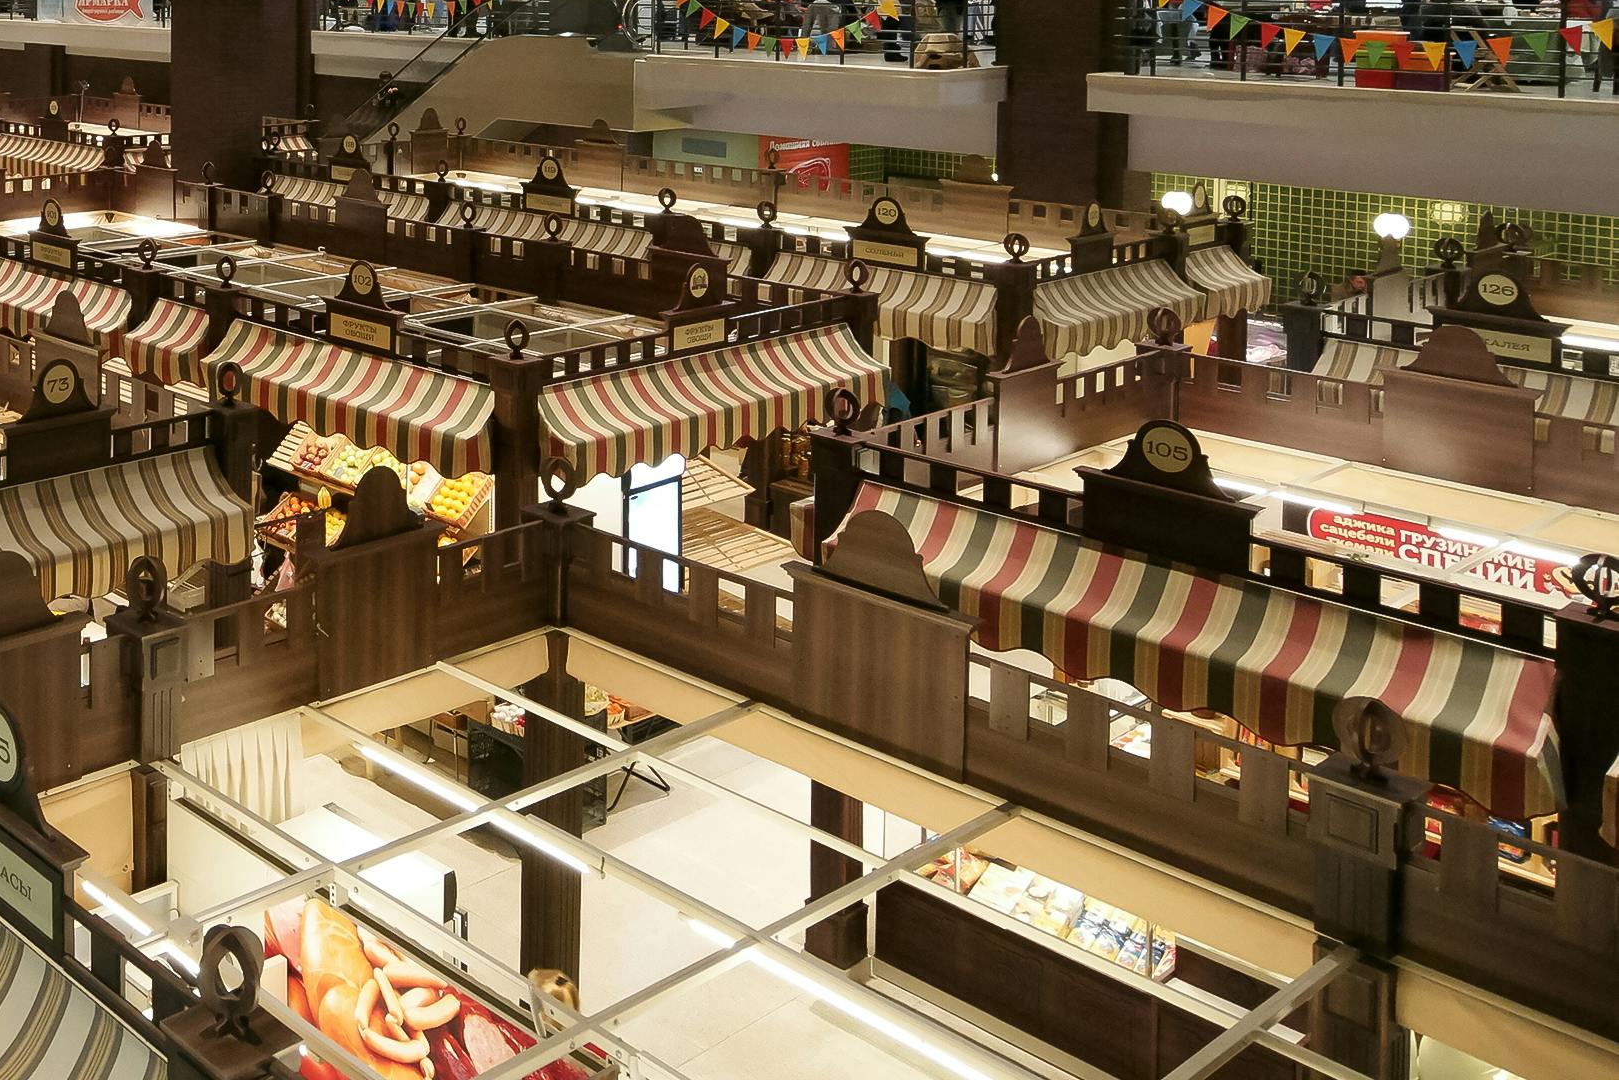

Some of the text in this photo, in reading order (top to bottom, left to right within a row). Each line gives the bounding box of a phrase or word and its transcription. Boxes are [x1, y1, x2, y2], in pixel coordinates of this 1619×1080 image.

[544, 164, 557, 174] 119
[877, 207, 897, 218] 120
[354, 274, 372, 287] 102
[1481, 282, 1515, 297] 126
[342, 319, 377, 335] ФРУКТЫ
[684, 324, 715, 336] ФРУКТЫ
[344, 328, 375, 342] ОВОЩИ
[686, 332, 712, 344] ОВОЩИ
[46, 376, 70, 393] 73
[1145, 440, 1189, 462] 105
[1333, 514, 1396, 537] аджика
[1319, 523, 1396, 548] сацебели
[1399, 529, 1536, 573] ГРУЗИНКИЕ
